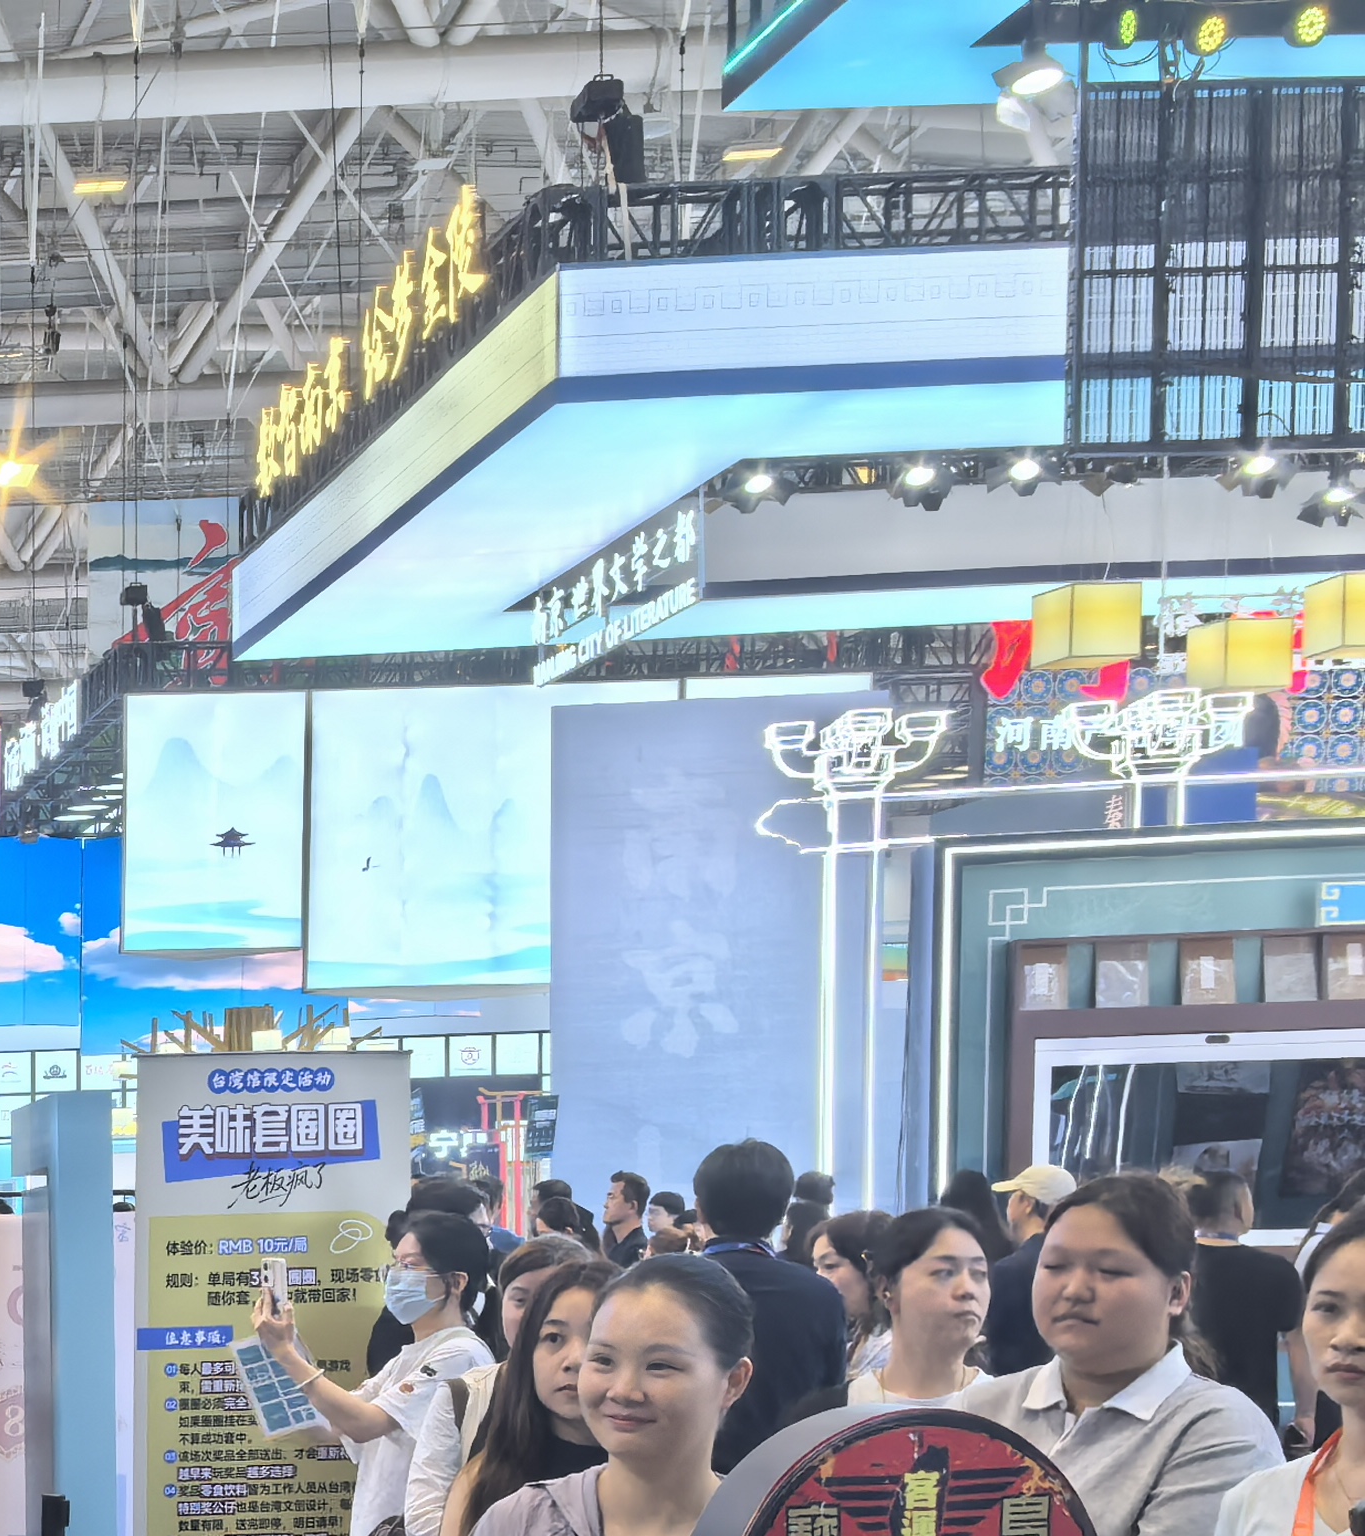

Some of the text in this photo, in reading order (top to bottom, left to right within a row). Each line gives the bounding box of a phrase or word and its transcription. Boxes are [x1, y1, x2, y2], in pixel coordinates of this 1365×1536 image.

[211, 1069, 332, 1090] 台湾馆限定活动
[178, 1103, 363, 1157] 美味套圈圈
[227, 1161, 325, 1209] 老板疯了
[219, 1239, 253, 1255] RMB
